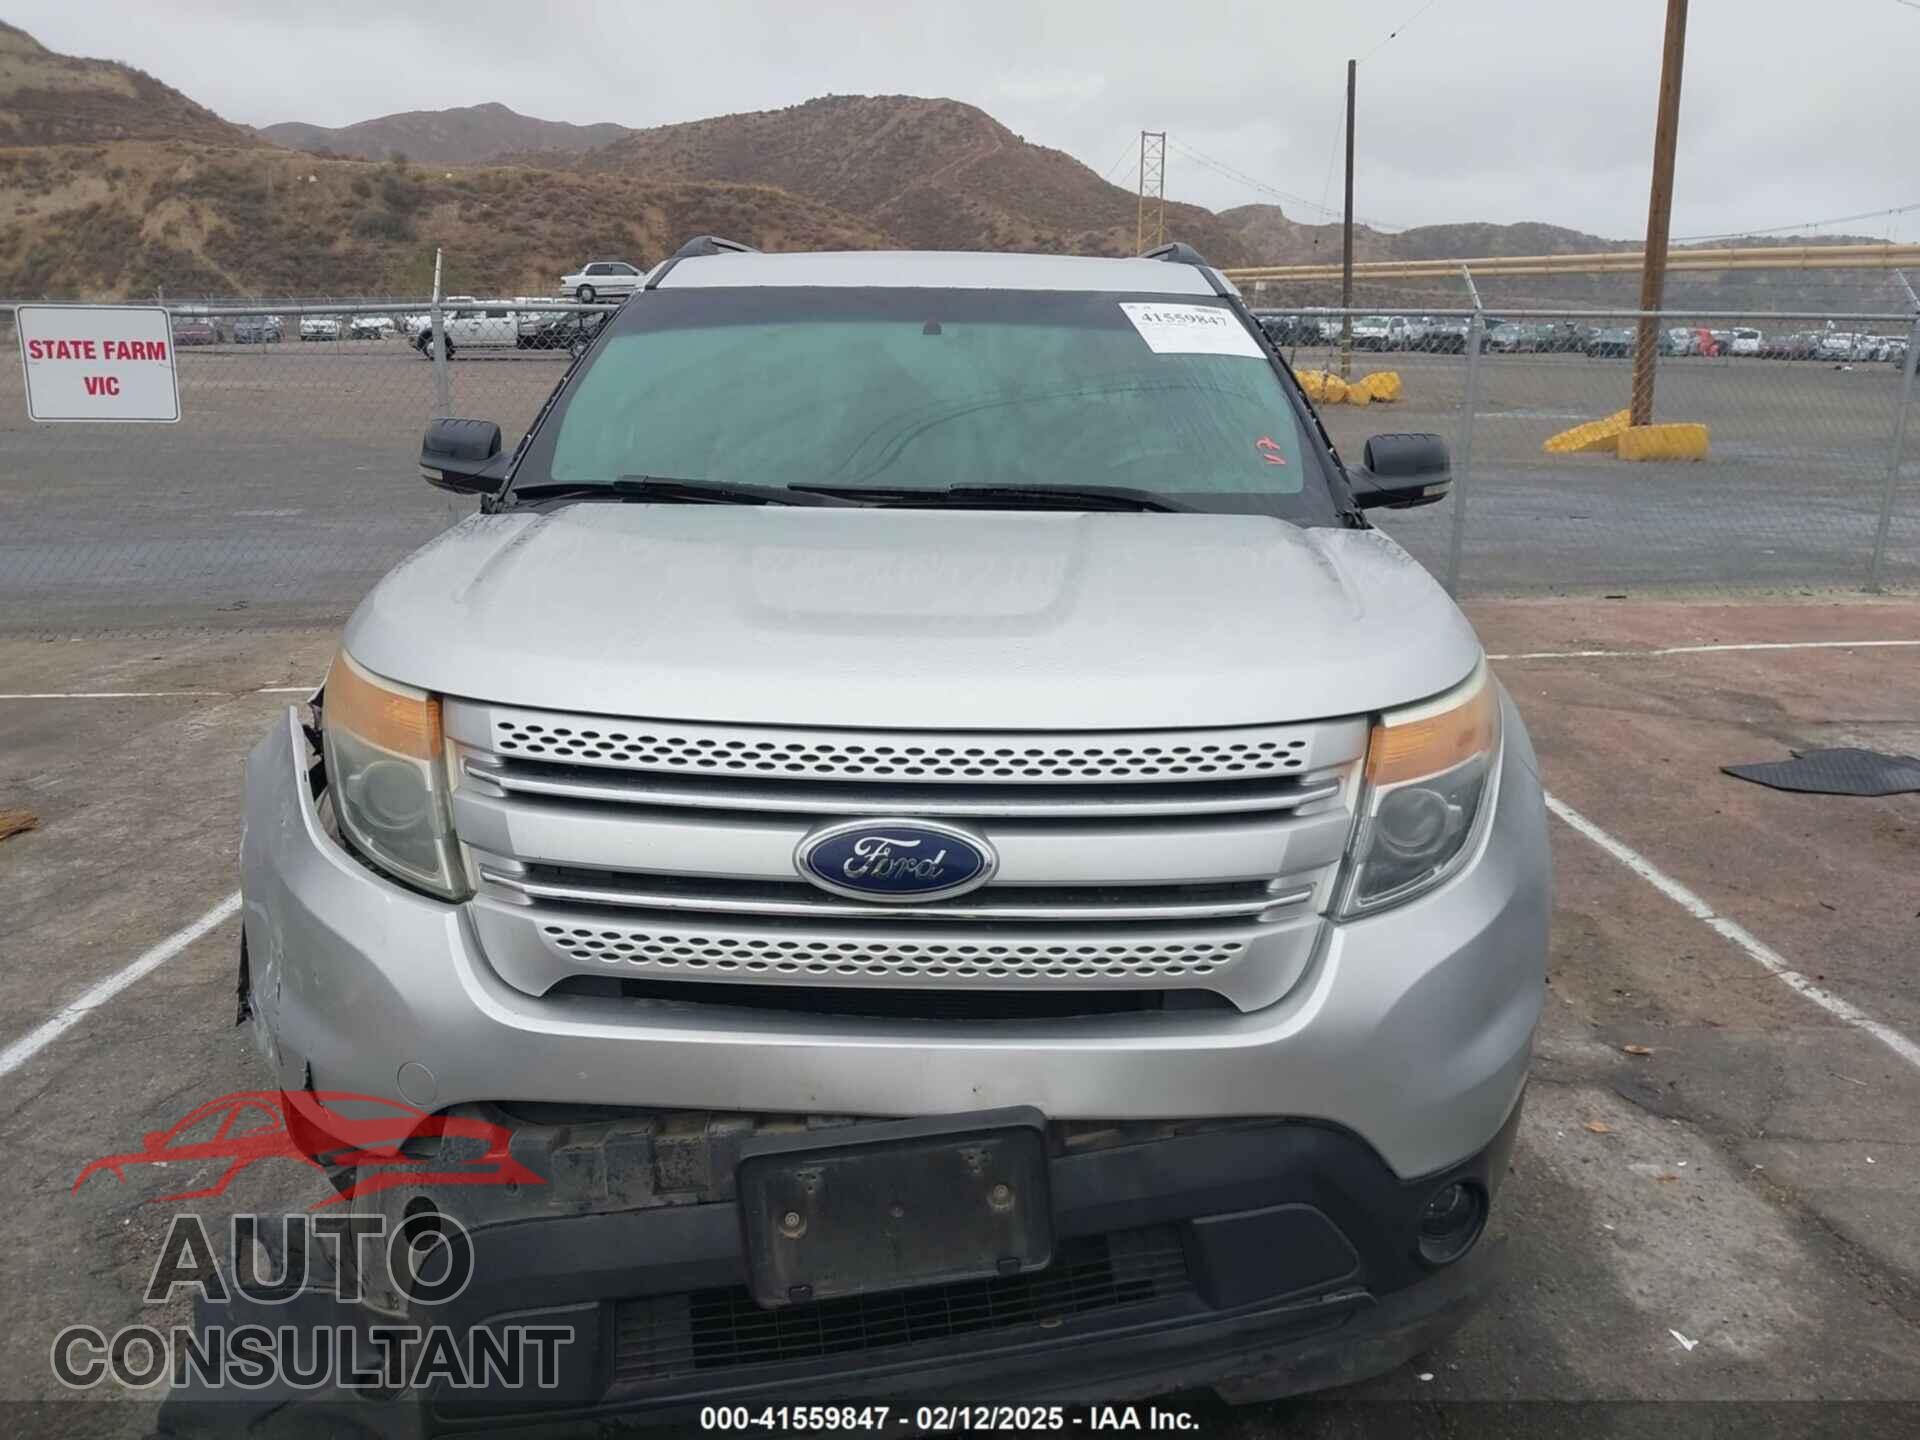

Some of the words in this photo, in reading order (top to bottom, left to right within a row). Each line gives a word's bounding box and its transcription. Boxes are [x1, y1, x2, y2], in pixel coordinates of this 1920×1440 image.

[1141, 312, 1227, 326] 41559847
[28, 339, 97, 359] STATE
[103, 341, 167, 361] FARM
[84, 376, 121, 396] VIC
[842, 836, 947, 880] Ford
